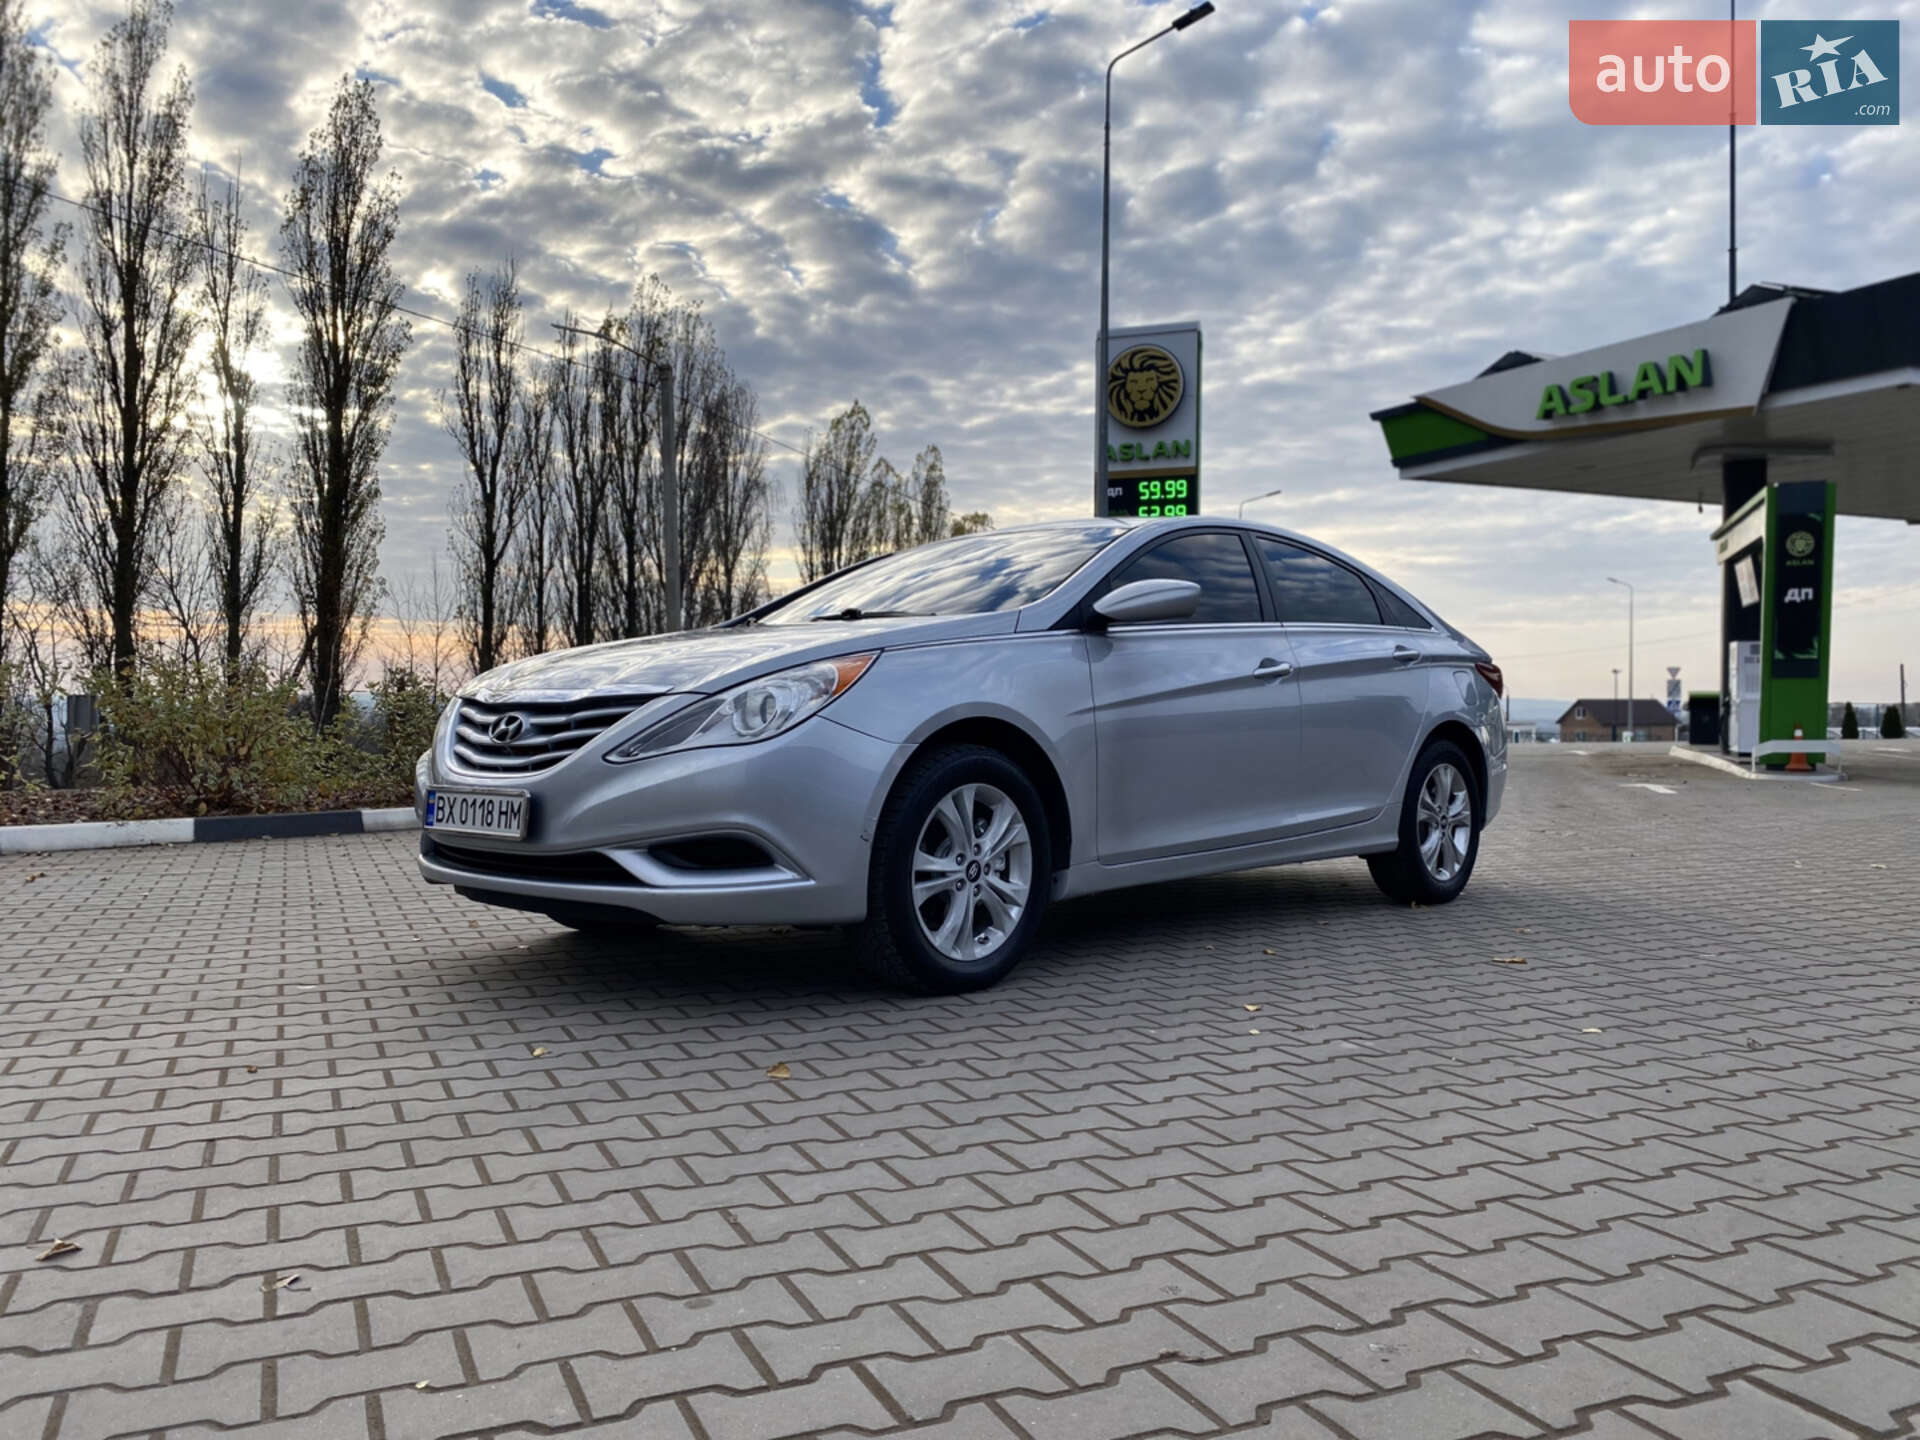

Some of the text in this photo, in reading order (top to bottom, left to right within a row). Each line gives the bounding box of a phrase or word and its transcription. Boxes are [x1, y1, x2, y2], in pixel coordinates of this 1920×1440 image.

[1536, 349, 1712, 420] ASLAN
[1138, 480, 1187, 500] 59.99
[1784, 588, 1813, 603] ДП
[460, 798, 494, 827] 0118
